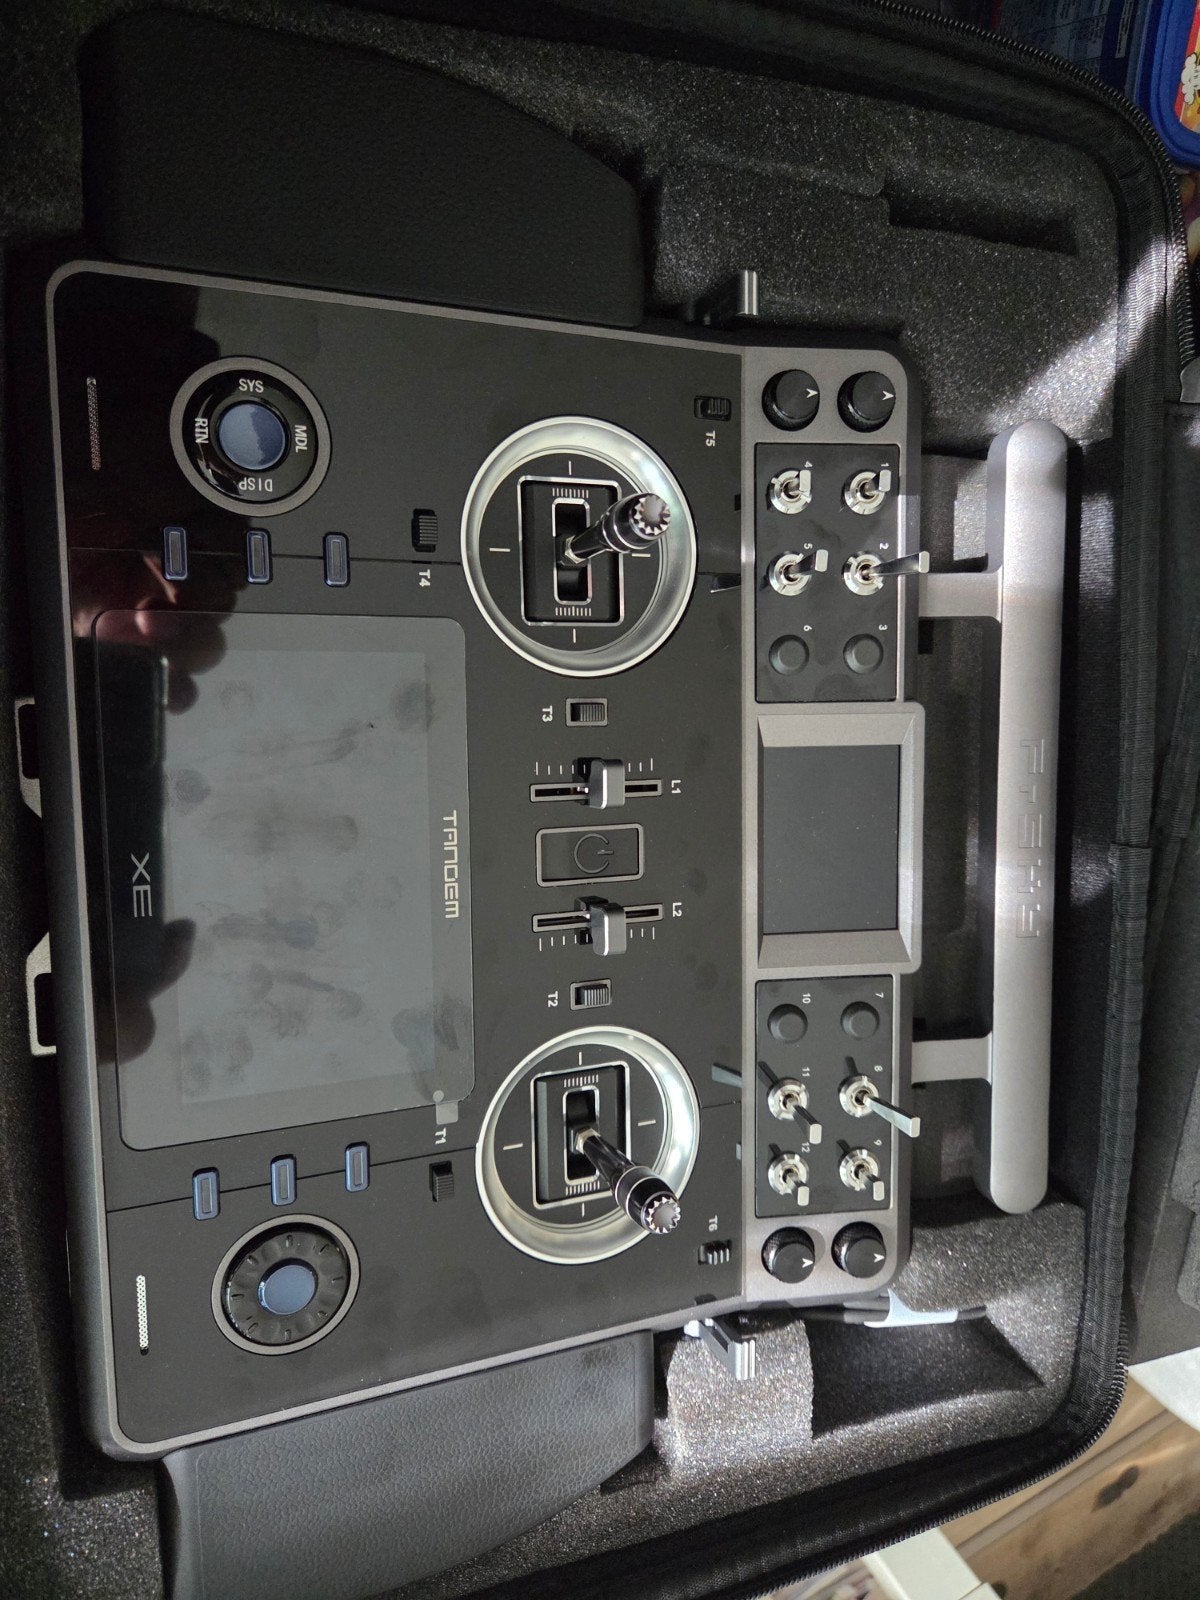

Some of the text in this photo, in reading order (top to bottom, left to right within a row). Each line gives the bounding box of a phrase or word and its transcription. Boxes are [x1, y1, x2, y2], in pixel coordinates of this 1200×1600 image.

[238, 378, 264, 393] SYS
[194, 417, 209, 444] RTN
[294, 424, 308, 453] MDL
[705, 430, 716, 447] T5
[803, 460, 813, 469] 4
[238, 477, 273, 492] DISP
[879, 542, 889, 550] 2
[418, 569, 431, 587] T4
[803, 624, 813, 632] 6
[542, 705, 553, 722] T3
[671, 779, 682, 794] L1
[442, 809, 459, 919] TANDEM
[131, 852, 153, 918] XE
[672, 902, 683, 918] L2
[547, 990, 559, 1008] T2
[802, 993, 811, 1004] 10
[802, 1066, 810, 1077] 11
[434, 1127, 447, 1145] T1
[801, 1141, 811, 1153] 12
[708, 1215, 718, 1232] T6
